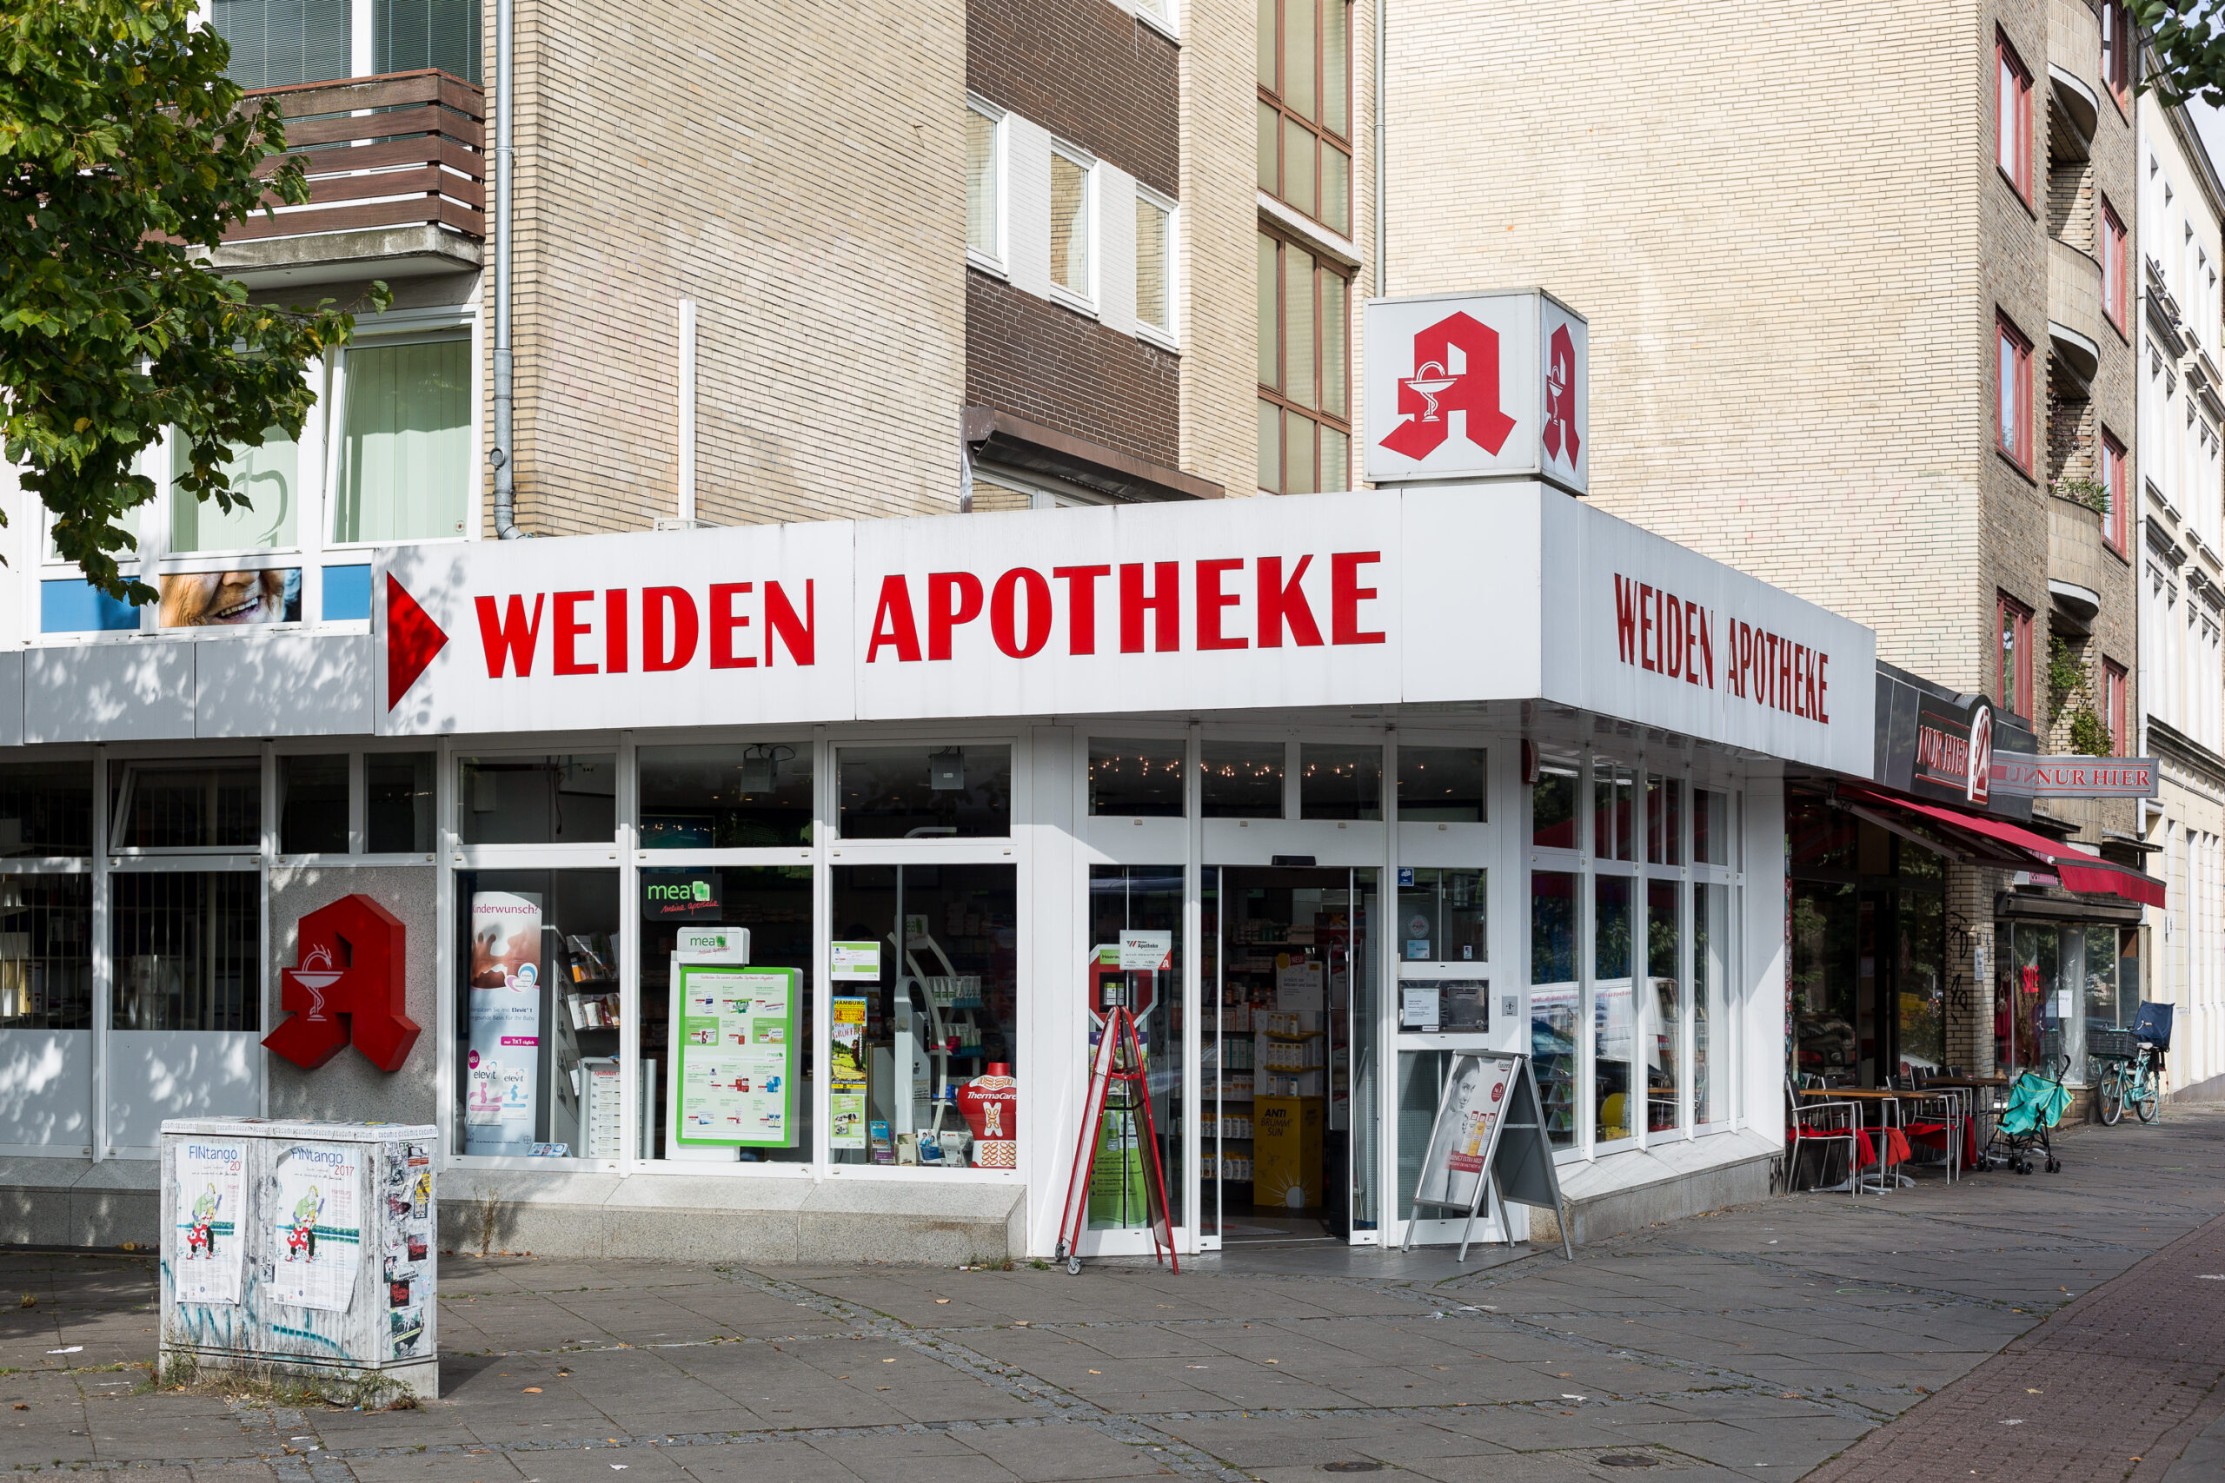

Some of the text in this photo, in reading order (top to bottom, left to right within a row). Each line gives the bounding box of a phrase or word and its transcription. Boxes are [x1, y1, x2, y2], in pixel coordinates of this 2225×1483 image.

[474, 551, 1386, 678] WEIDEN APOTHEKE
[1614, 573, 1829, 725] WEIDEN APOTHEKE
[1916, 724, 1969, 777] NUR HIER
[2036, 768, 2150, 786] NUR HIER
[647, 885, 690, 899] mea
[690, 937, 715, 946] mea
[473, 1069, 497, 1079] elevit
[1265, 1109, 1287, 1117] ANTI
[1267, 1128, 1284, 1136] SUN
[188, 1145, 238, 1163] FINtango
[290, 1147, 343, 1167] FINtango
[335, 1165, 355, 1176] 2017
